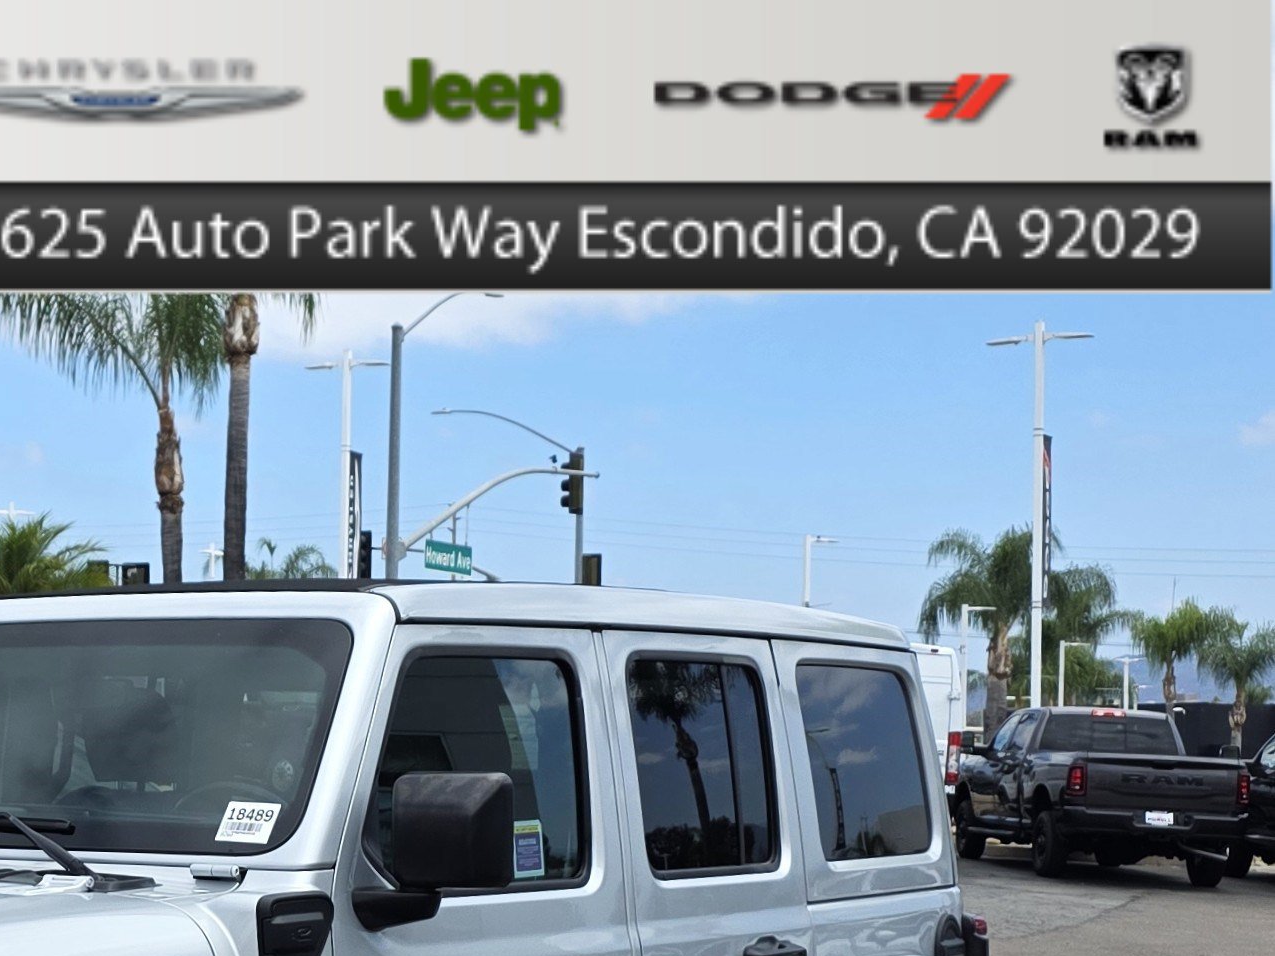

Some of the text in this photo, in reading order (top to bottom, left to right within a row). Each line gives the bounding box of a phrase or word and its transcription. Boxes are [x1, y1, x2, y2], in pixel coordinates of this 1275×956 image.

[426, 545, 472, 571] Howard Ave
[1122, 773, 1204, 787] RAM
[227, 807, 274, 823] 18489
